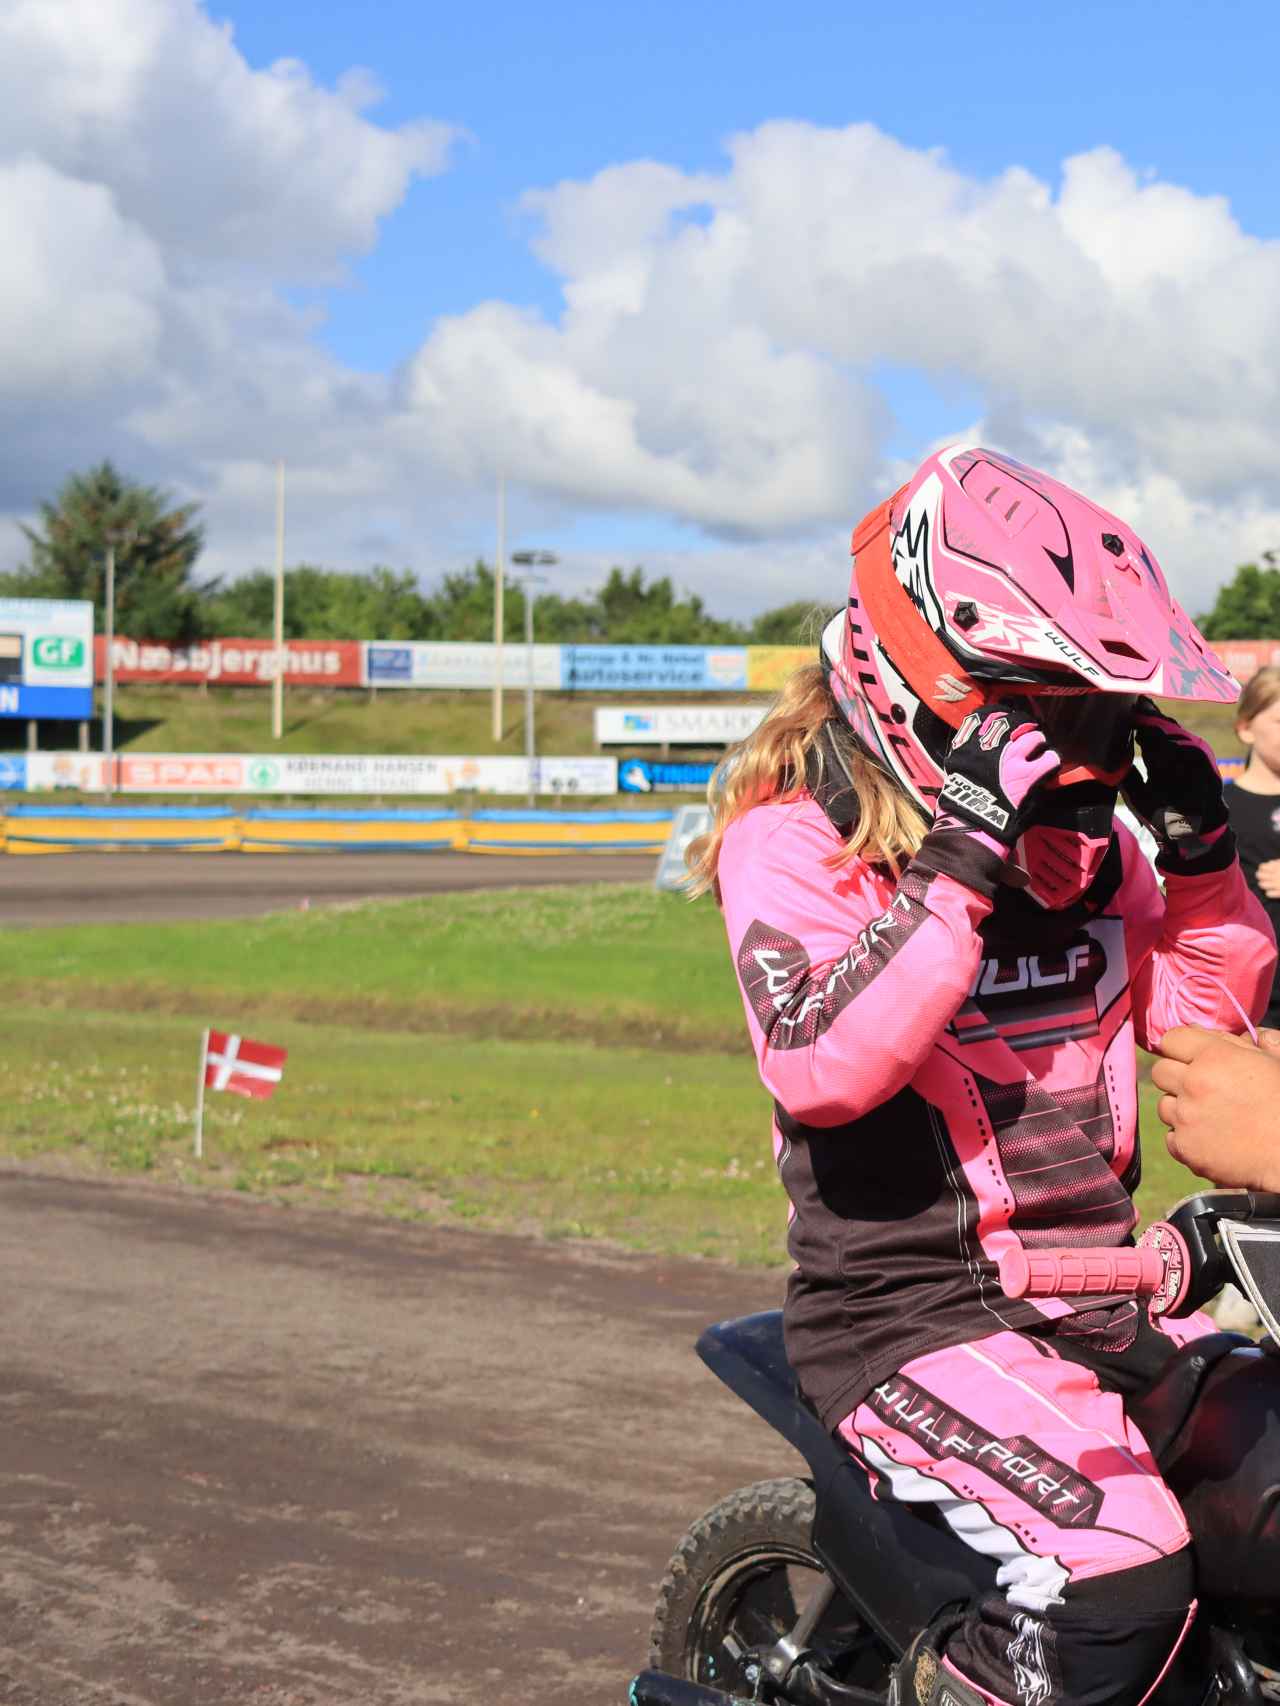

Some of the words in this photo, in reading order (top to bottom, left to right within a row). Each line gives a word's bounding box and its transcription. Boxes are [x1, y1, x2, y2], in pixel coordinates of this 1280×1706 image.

[38, 639, 81, 664] GF
[1044, 631, 1100, 676] WULF
[129, 763, 240, 784] SPAR
